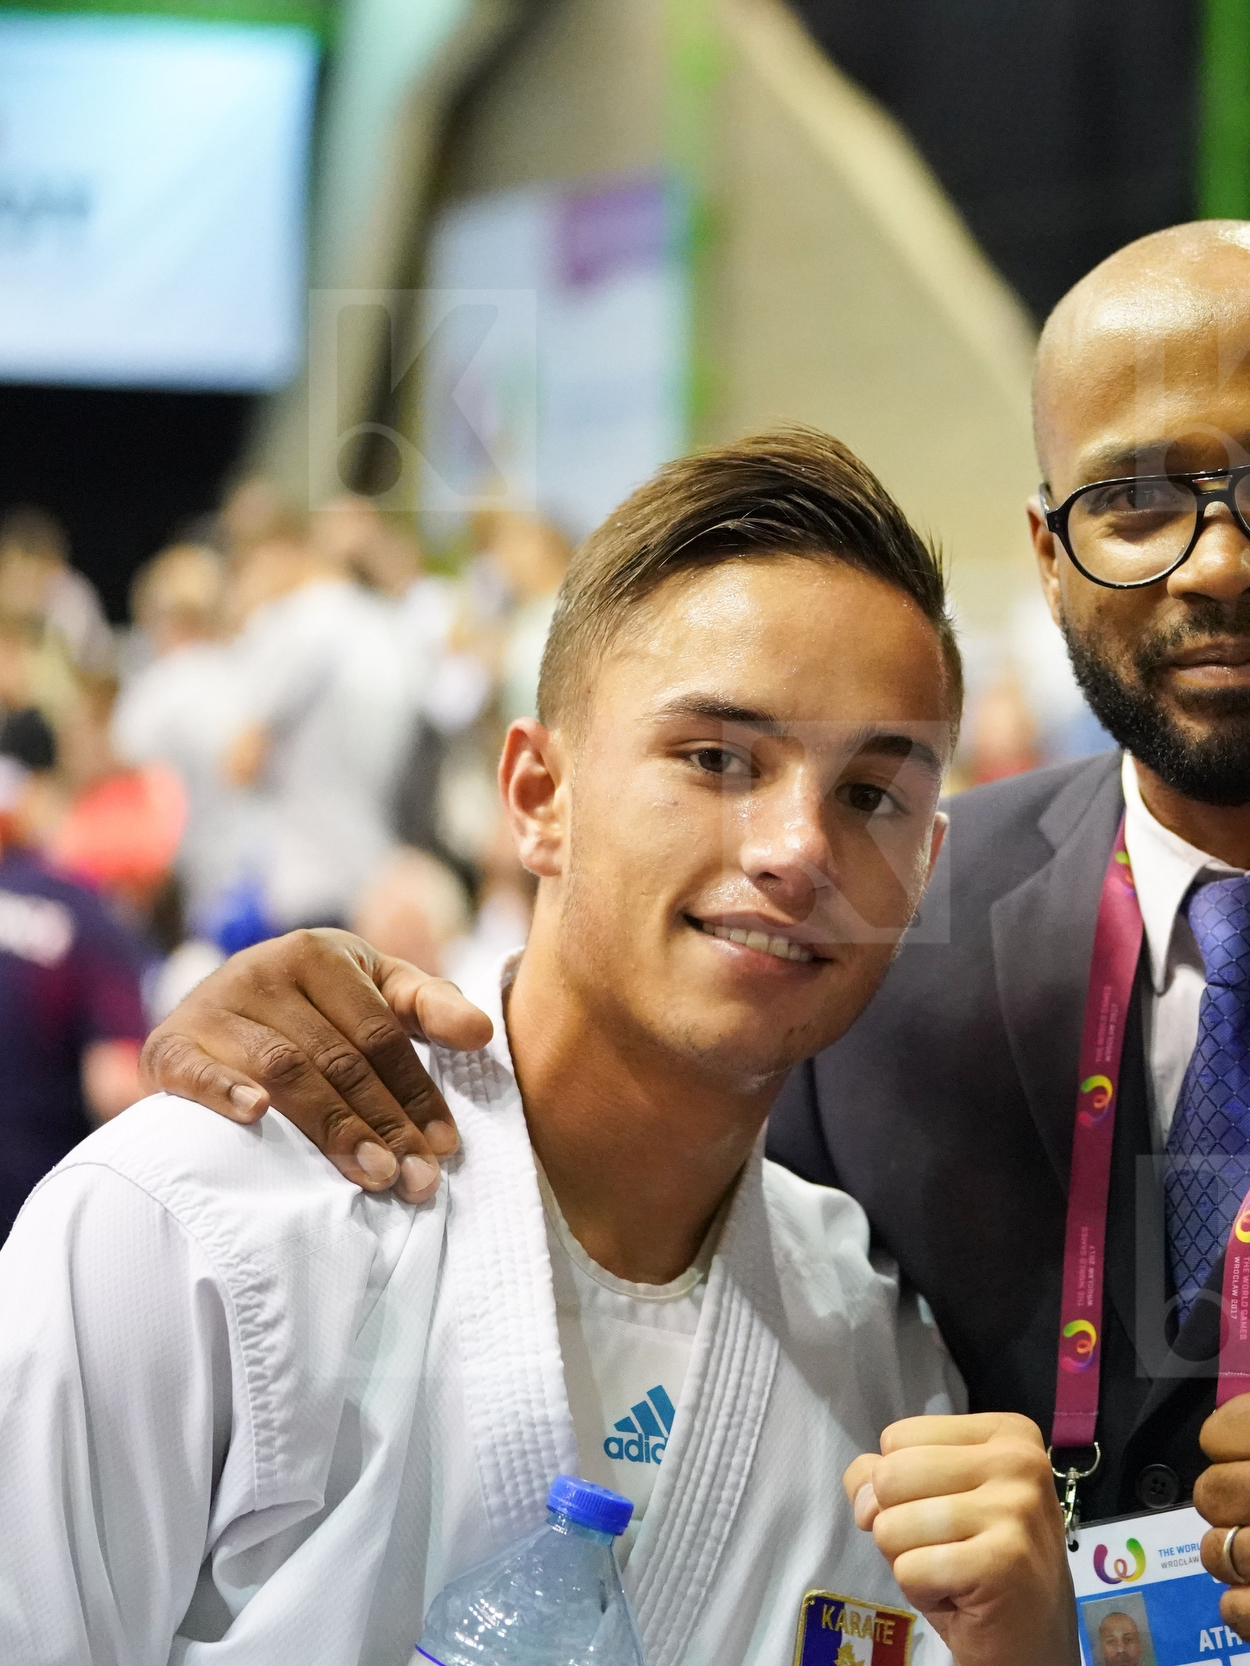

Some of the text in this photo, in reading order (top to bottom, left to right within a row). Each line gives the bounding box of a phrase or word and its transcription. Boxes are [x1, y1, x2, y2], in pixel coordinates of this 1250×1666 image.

[1230, 1298, 1239, 1320] 2017
[1239, 1256, 1250, 1341] THE WORLD GAMES
[1158, 1547, 1175, 1558] THE
[1161, 1555, 1199, 1569] WROCŁAW
[821, 1604, 895, 1645] KARATE
[1199, 1625, 1243, 1652] ATH
